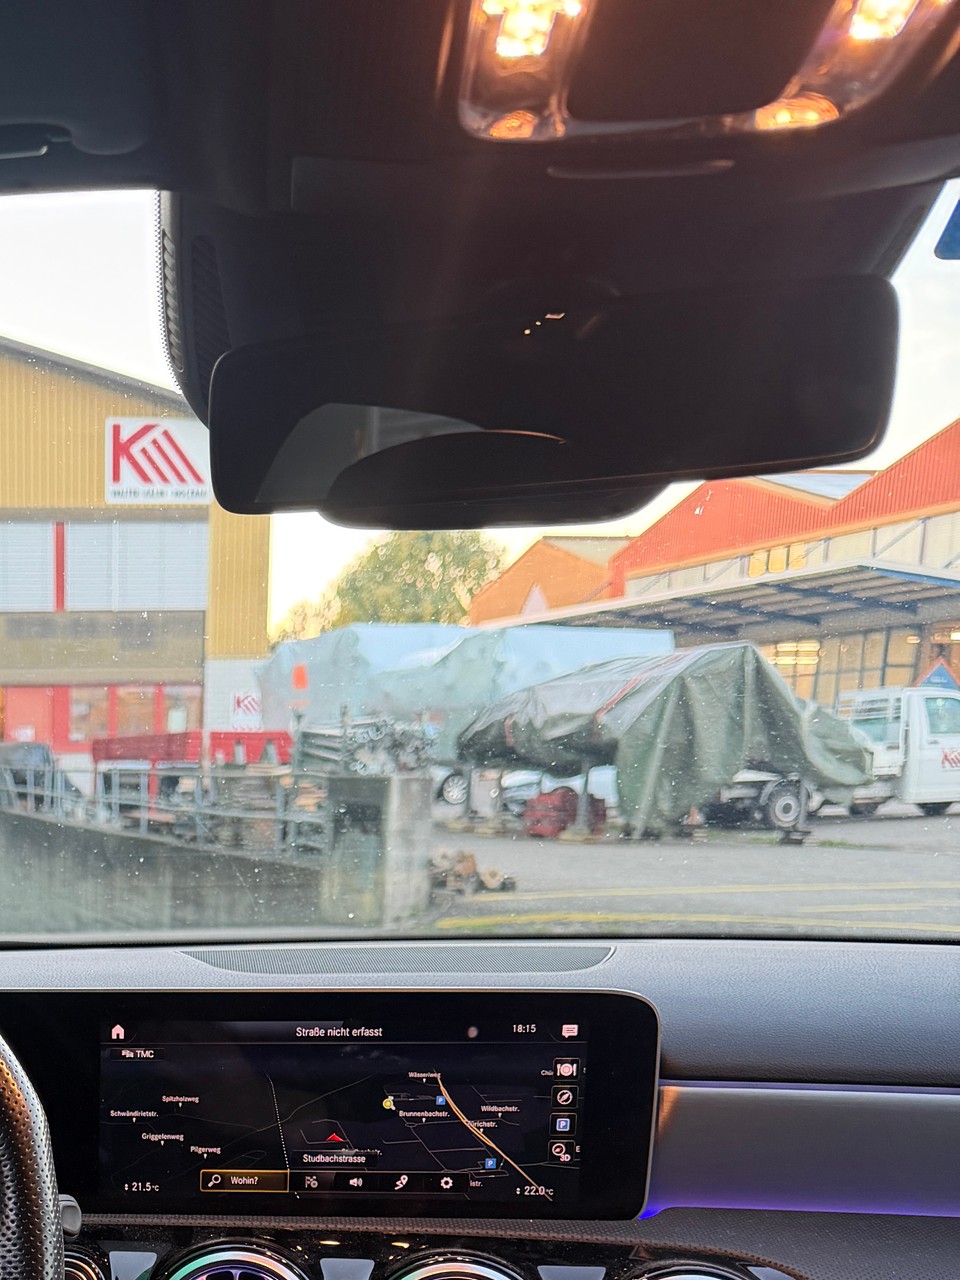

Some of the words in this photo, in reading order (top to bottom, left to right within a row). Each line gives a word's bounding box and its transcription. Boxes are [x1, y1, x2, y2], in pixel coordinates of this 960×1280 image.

[296, 1027, 325, 1038] Straße
[328, 1027, 350, 1038] nicht
[352, 1027, 383, 1038] erfasst
[512, 1024, 537, 1034] 18:15
[136, 1050, 154, 1058] TMC
[141, 1132, 184, 1142] Griggelenweg
[190, 1146, 221, 1154] Pilgerweg
[302, 1154, 366, 1163] Studbachstrasse
[230, 1176, 259, 1186] Wohin?
